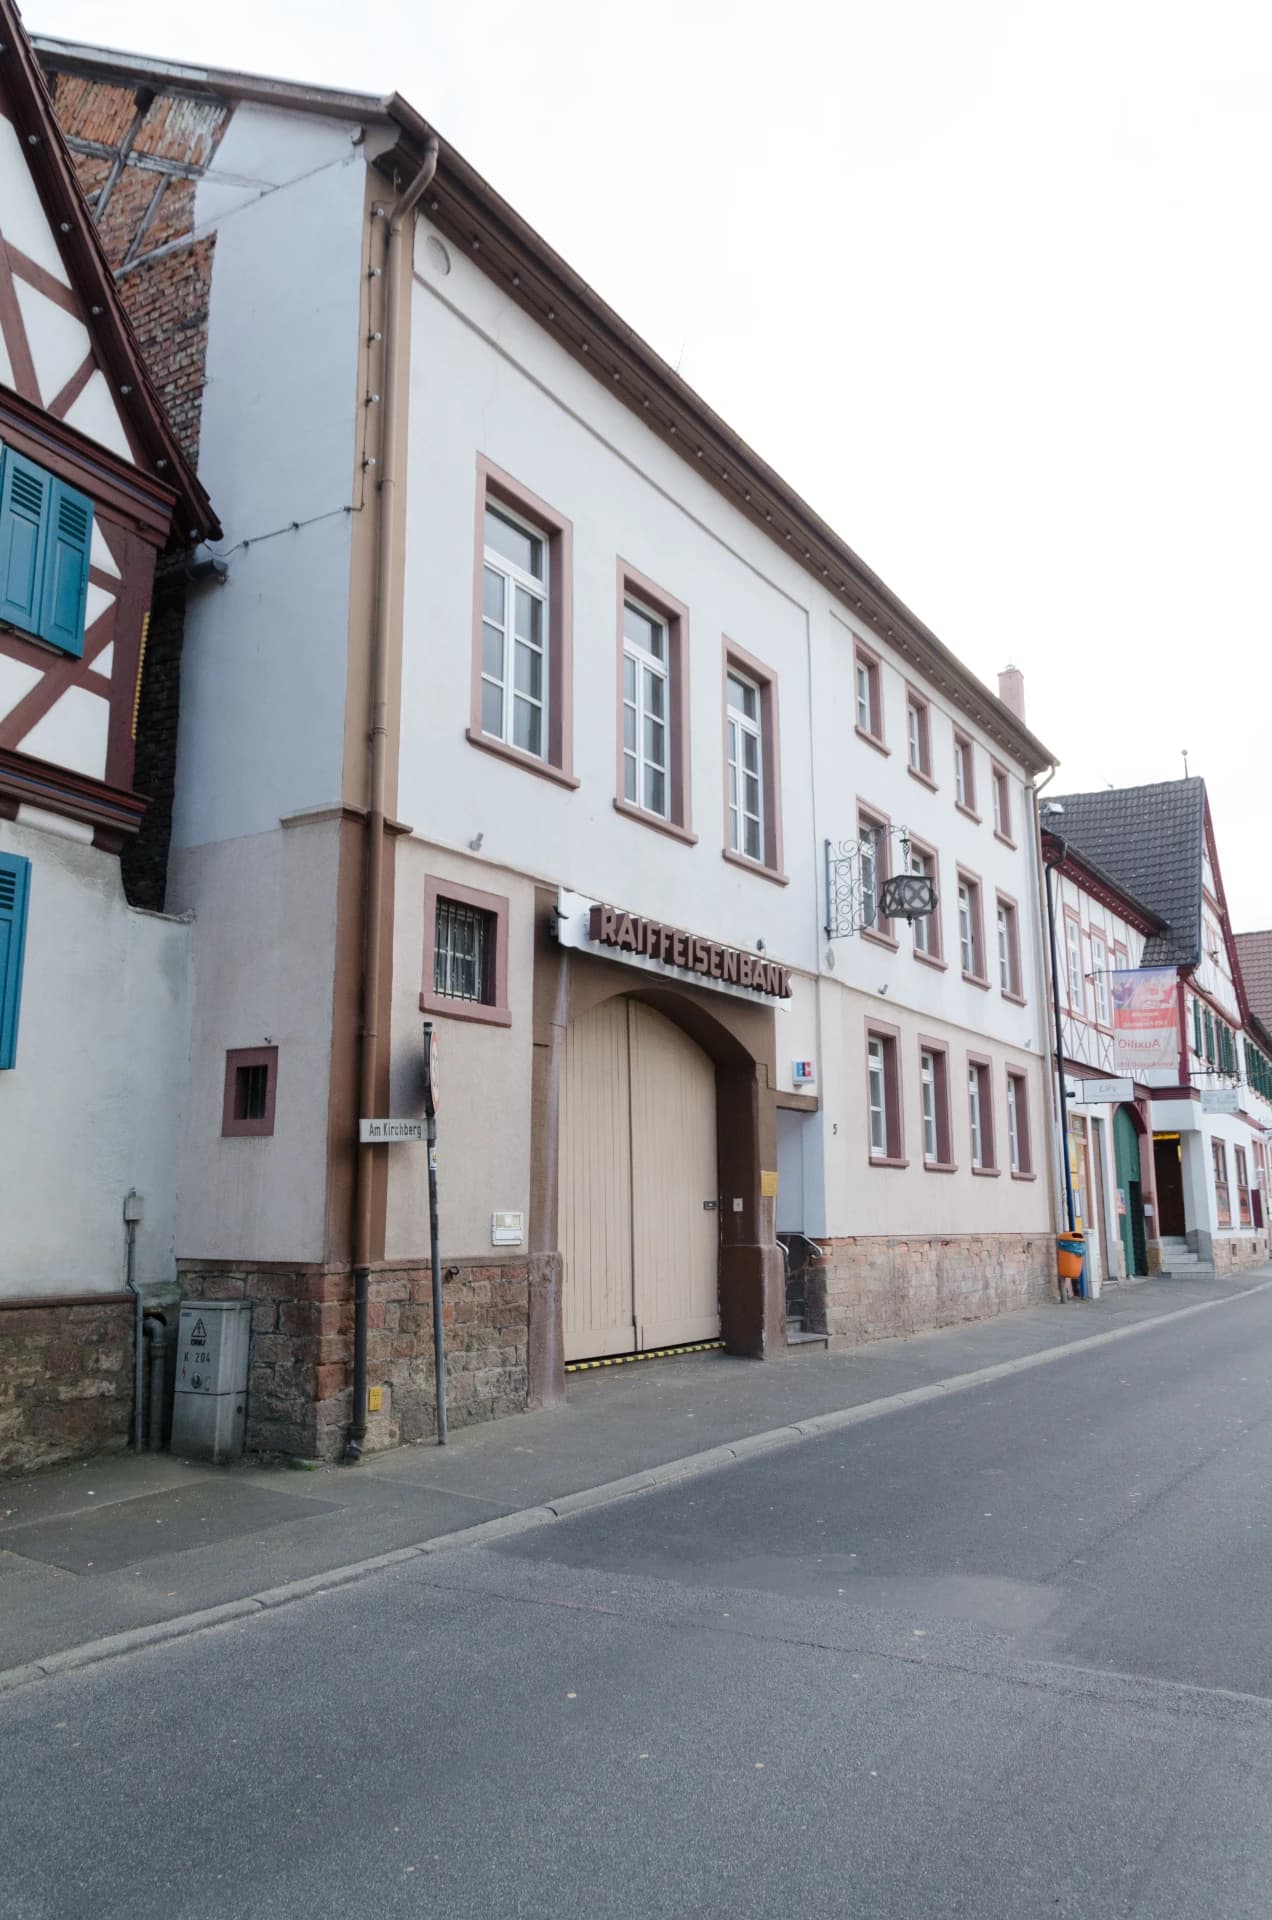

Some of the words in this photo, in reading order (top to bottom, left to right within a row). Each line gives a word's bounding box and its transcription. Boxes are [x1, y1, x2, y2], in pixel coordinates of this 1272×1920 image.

[595, 903, 793, 998] RAIFFEISENBANK
[369, 1123, 381, 1136] Am
[383, 1122, 422, 1139] Kirchberg
[833, 1123, 838, 1136] 5
[195, 1352, 211, 1363] 204
